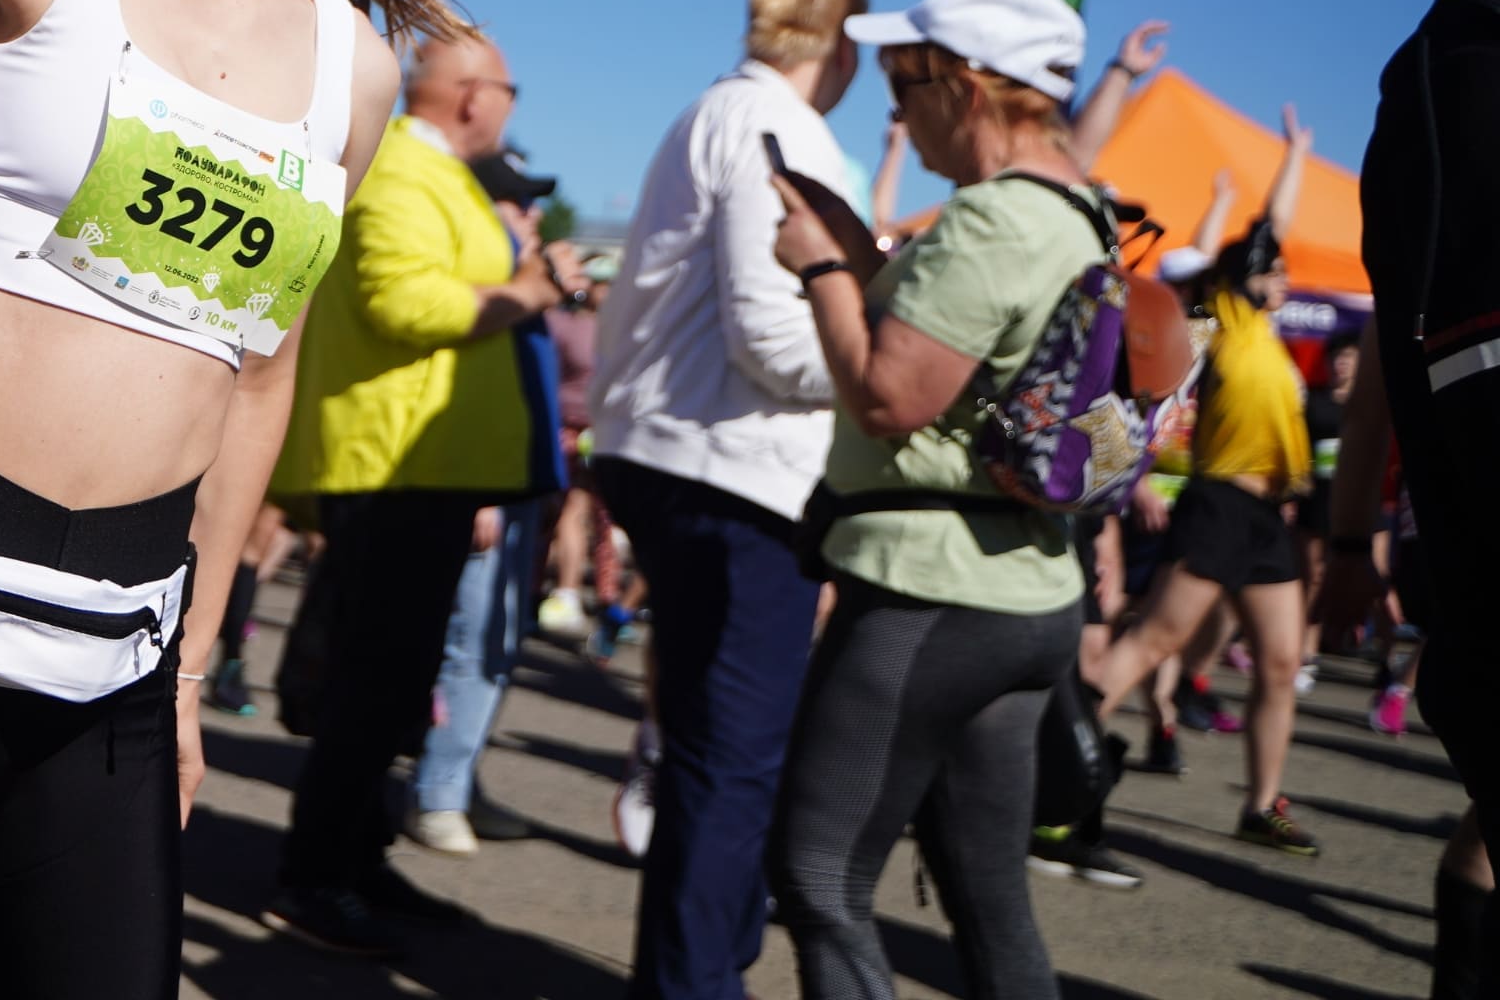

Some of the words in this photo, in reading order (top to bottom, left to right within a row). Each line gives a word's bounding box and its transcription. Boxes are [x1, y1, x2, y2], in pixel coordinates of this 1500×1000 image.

[125, 168, 275, 269] 3279
[164, 264, 200, 284] 12.06.2022
[205, 311, 221, 326] 10
